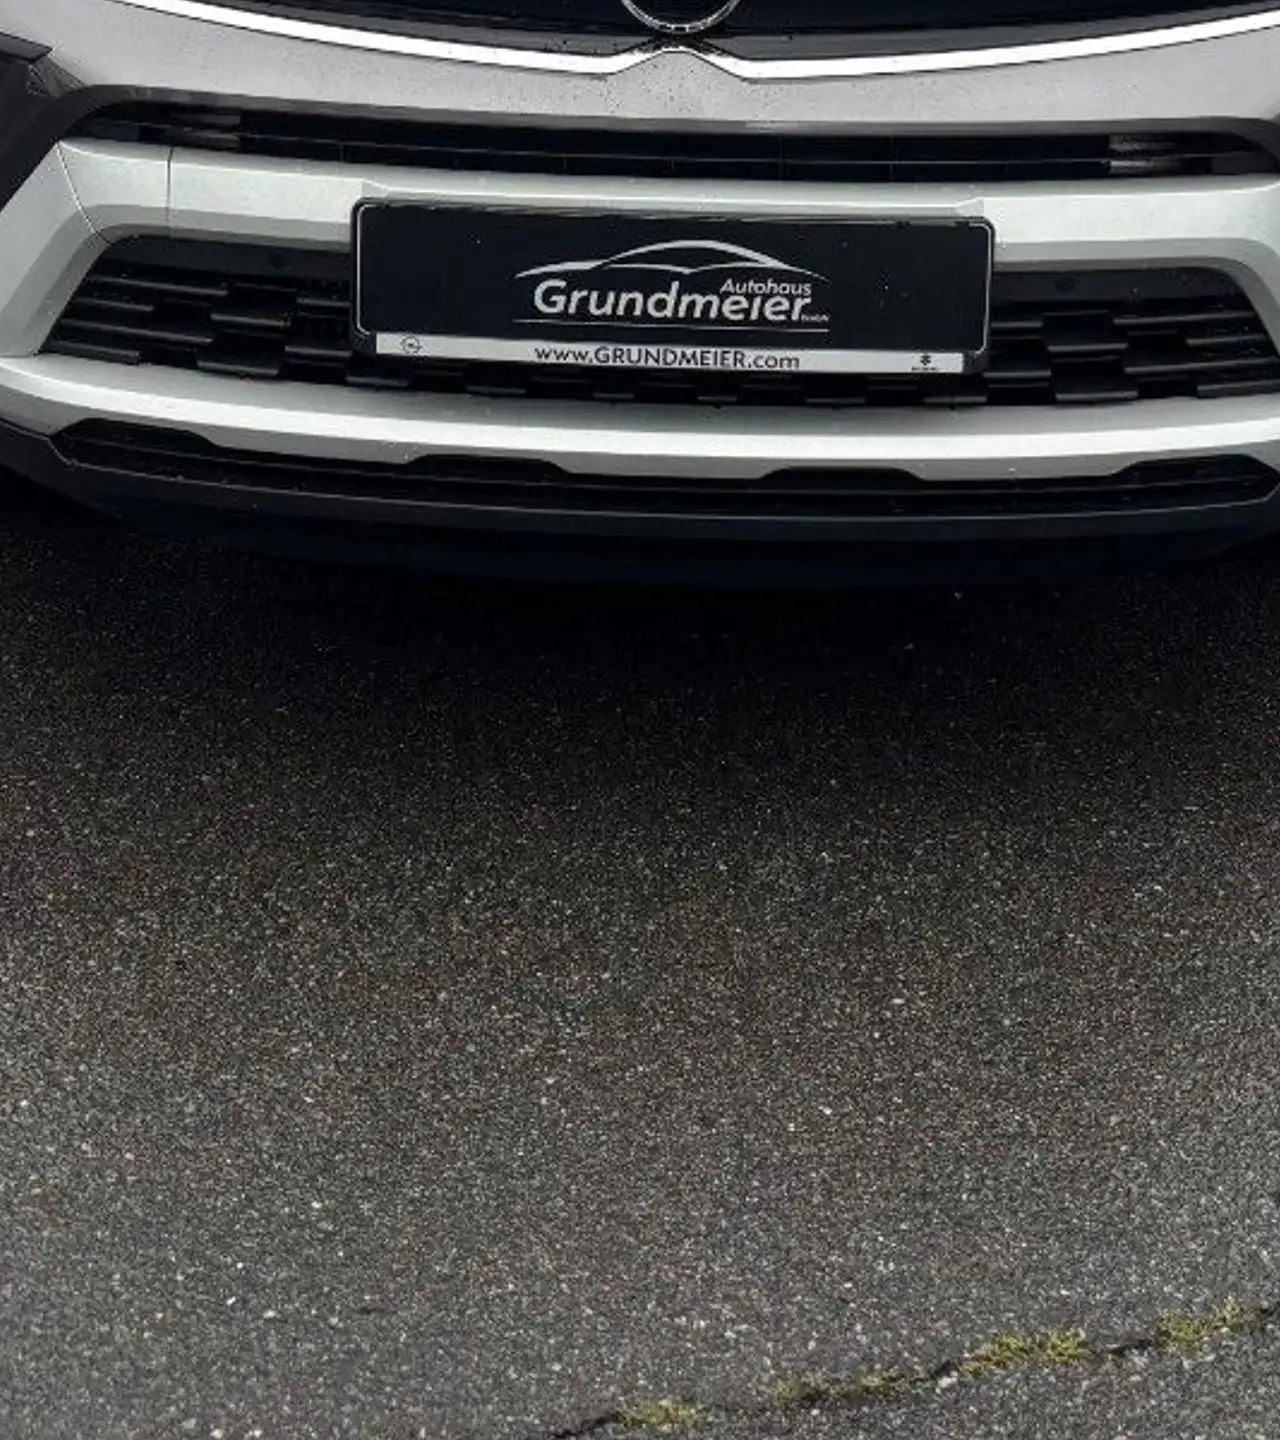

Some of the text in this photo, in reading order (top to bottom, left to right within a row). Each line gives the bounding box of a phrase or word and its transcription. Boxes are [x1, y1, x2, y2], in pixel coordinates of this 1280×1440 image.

[720, 278, 812, 296] Autohaus
[534, 278, 812, 321] Grundmeier
[535, 346, 801, 370] www.GRUNDMEIER.com
